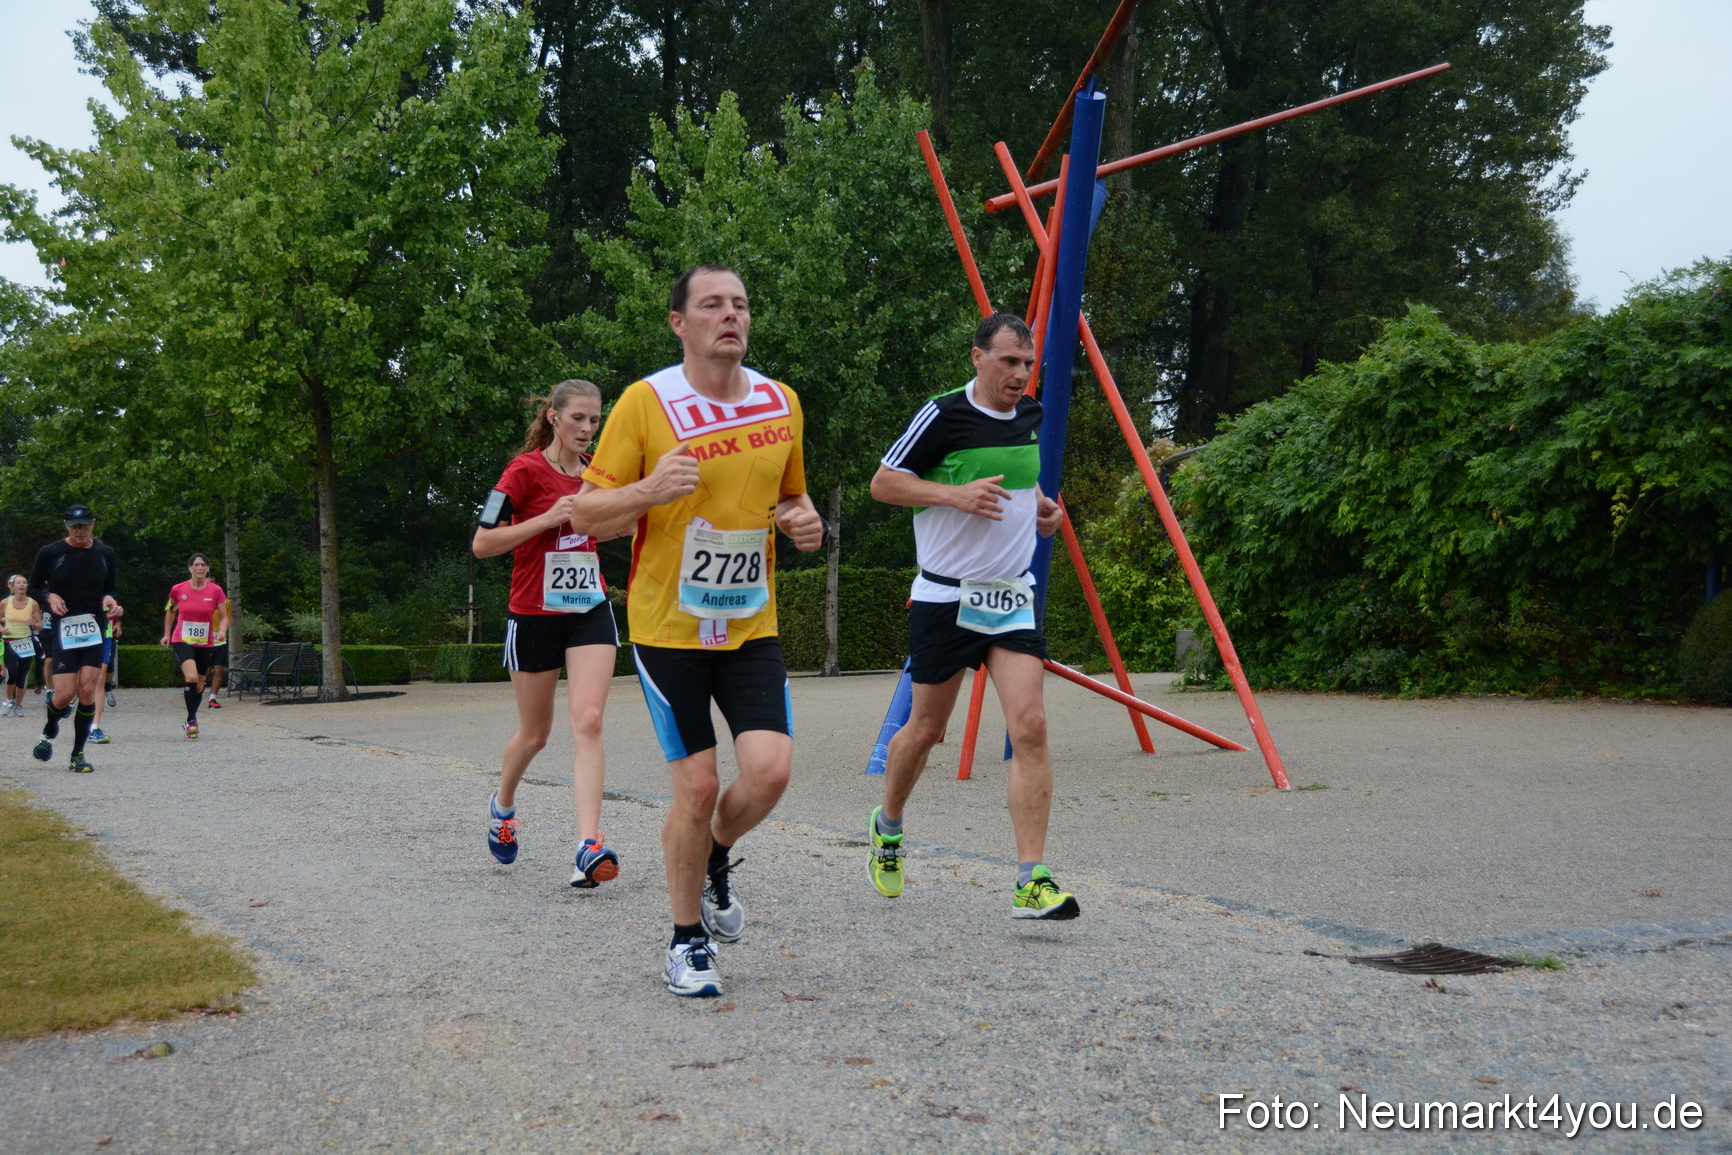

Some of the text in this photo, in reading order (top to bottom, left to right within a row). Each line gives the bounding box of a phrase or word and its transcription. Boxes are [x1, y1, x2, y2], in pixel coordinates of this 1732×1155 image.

[684, 425, 795, 463] MAX BÖGL
[691, 549, 761, 585] 2728
[551, 567, 597, 590] 2324
[562, 595, 591, 605] Marina
[701, 591, 748, 607] Andreas
[64, 621, 96, 637] 2705
[188, 627, 205, 637] 189
[13, 642, 32, 652] 2131
